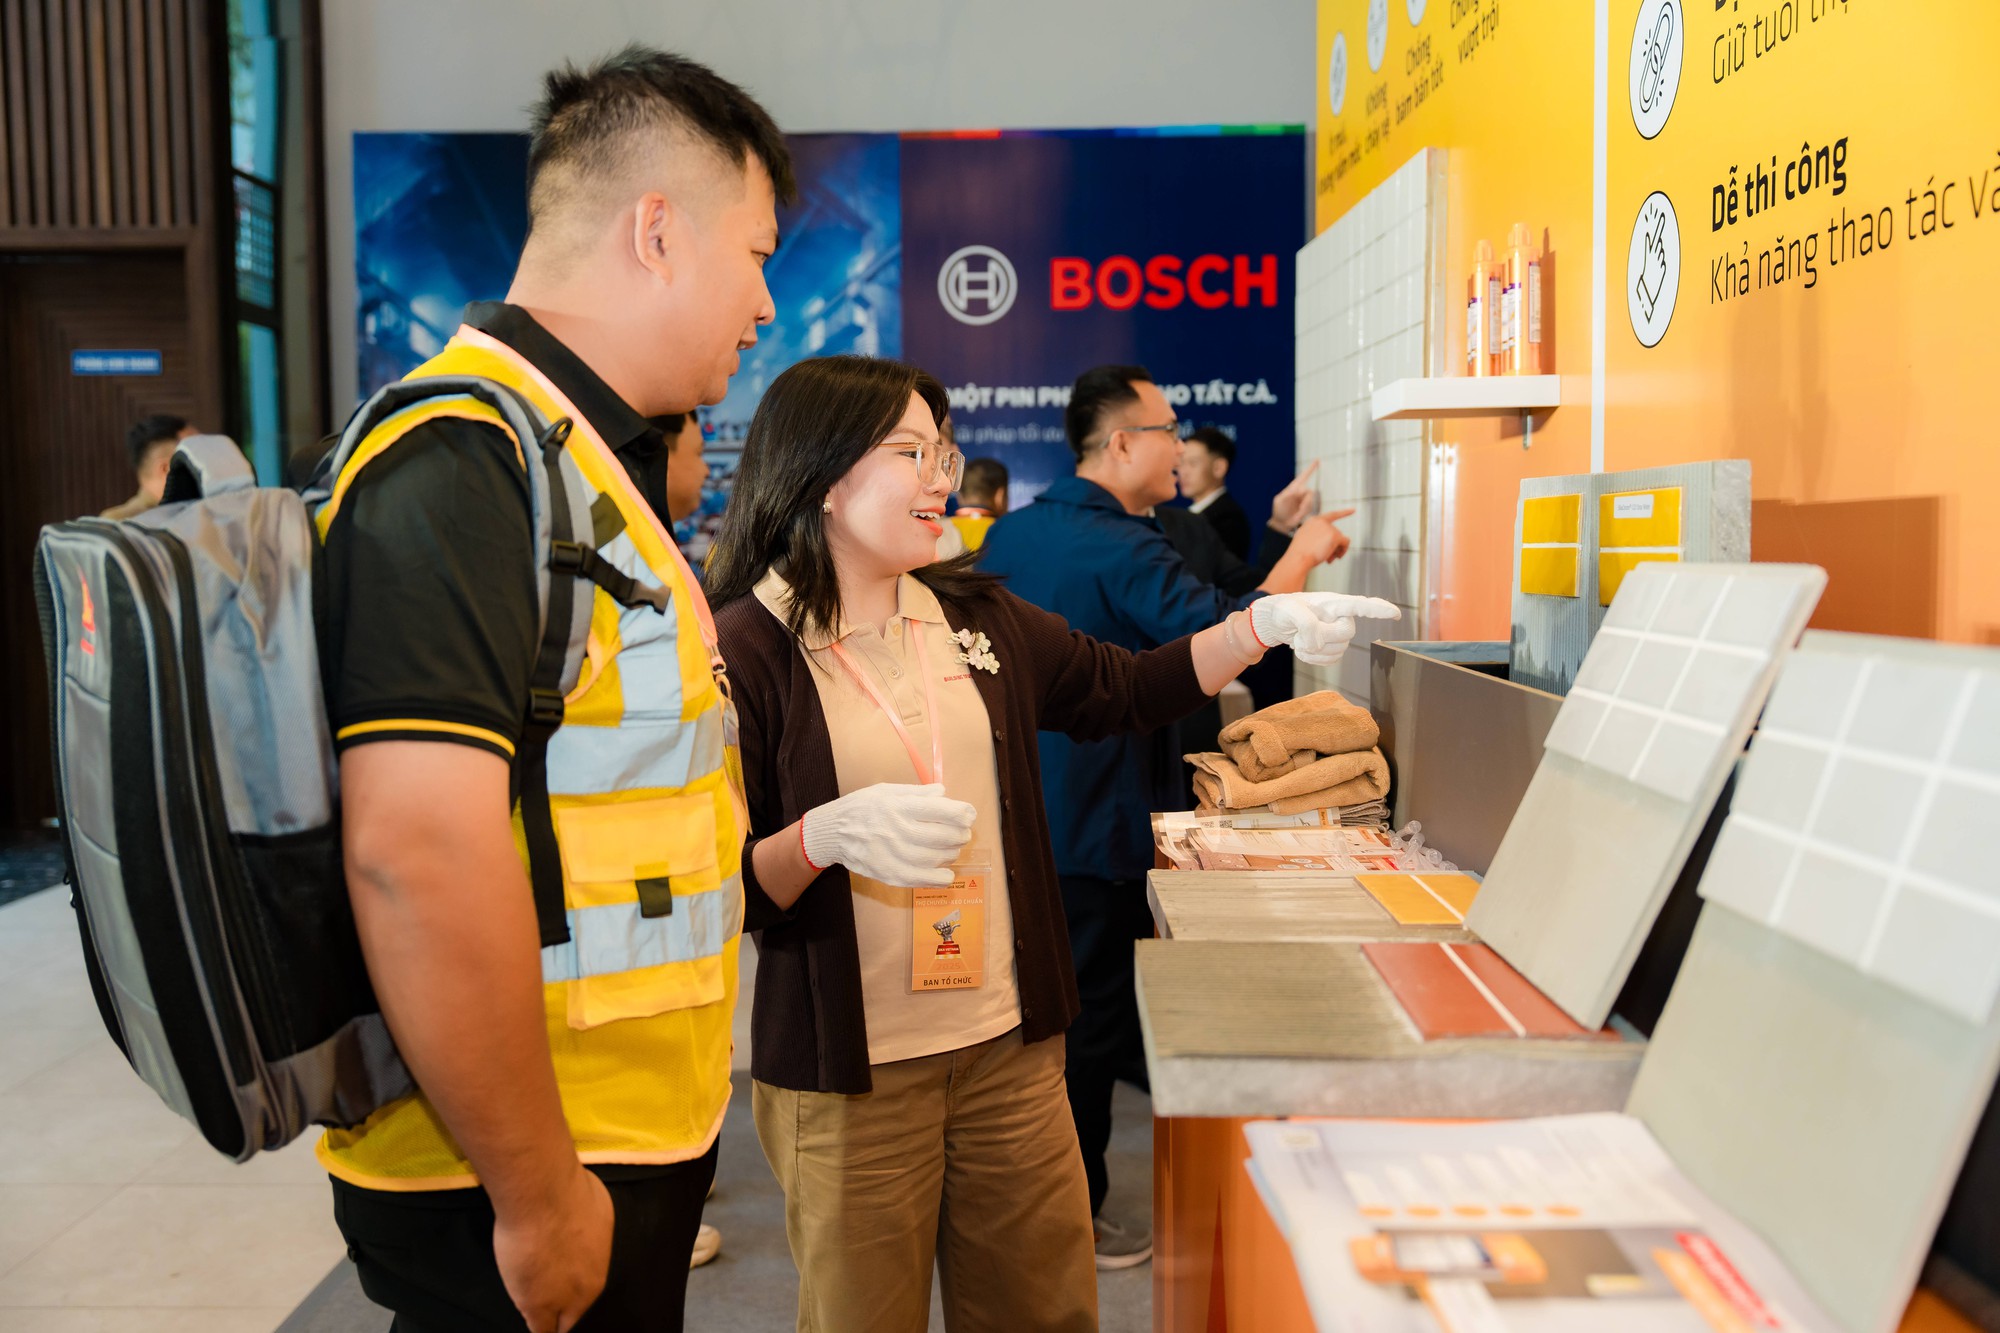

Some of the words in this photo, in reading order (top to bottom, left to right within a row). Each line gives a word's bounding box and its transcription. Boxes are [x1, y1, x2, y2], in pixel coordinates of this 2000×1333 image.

[1713, 22, 1746, 84] Giữ
[1711, 164, 1738, 233] Dễ
[1744, 155, 1777, 218] thi
[1784, 136, 1849, 201] công
[1711, 240, 1750, 305] Khả
[1758, 232, 1818, 289] năng
[1827, 206, 1893, 266] thao
[1905, 175, 1956, 241] tác
[1050, 254, 1278, 311] BOSCH
[994, 386, 1036, 409] PIN
[1191, 378, 1237, 405] TẤT
[923, 978, 939, 987] BAN
[953, 976, 972, 985] CHỨC
